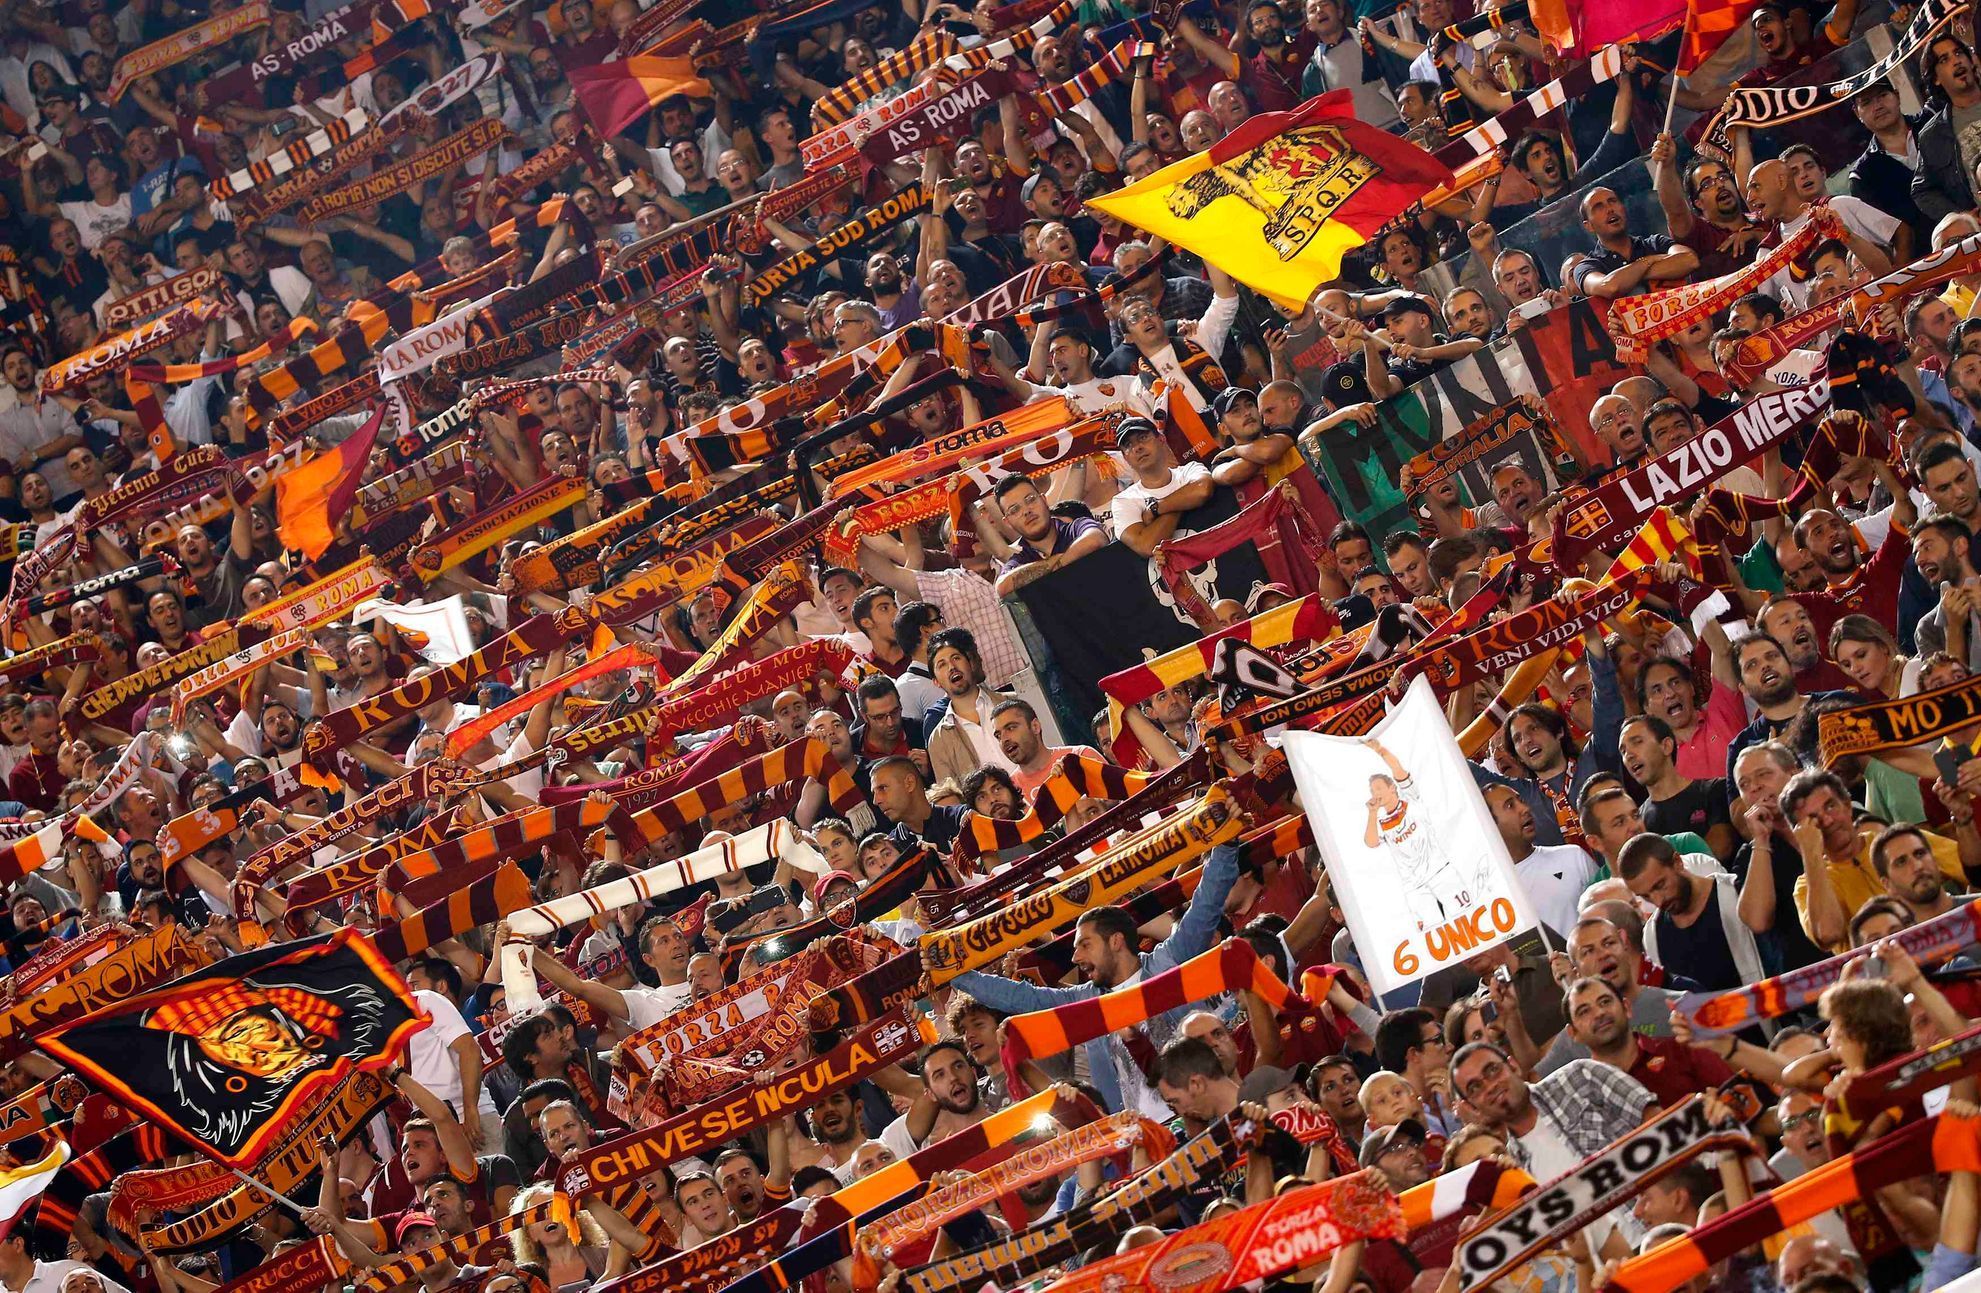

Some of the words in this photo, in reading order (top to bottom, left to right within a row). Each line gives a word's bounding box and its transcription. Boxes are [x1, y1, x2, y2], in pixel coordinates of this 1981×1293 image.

[291, 19, 348, 64] ROMA
[929, 82, 991, 130] ROMA
[336, 128, 386, 165] ROMA
[303, 198, 324, 220] LA
[325, 186, 366, 214] ROMA
[366, 176, 398, 201] NON
[413, 145, 468, 177] DISCUTE
[816, 219, 865, 256] SUD
[868, 187, 935, 229] ROMA
[109, 286, 168, 320] OTTI
[66, 319, 172, 382] ROMA
[412, 321, 465, 360] ROM
[446, 332, 533, 376] FORZA
[419, 398, 471, 438] roma
[933, 418, 1010, 456] roma
[1619, 427, 1735, 514] LAZIO
[1733, 377, 1830, 453] MERD
[146, 492, 226, 544] OMA
[245, 440, 304, 488] 927
[872, 486, 946, 524] FORZ
[456, 488, 562, 546] ASSOCIAZIONE
[781, 539, 815, 567] FORTI
[74, 566, 141, 596] roma
[316, 570, 374, 613] ROMA
[1475, 643, 1533, 675] VENI
[1535, 617, 1584, 649] VIDI
[1586, 589, 1633, 622] VICI
[179, 660, 231, 694] ORZA
[351, 630, 536, 732] ROMA
[705, 664, 762, 696] CLUB
[668, 693, 743, 731] VECCHIE
[1260, 706, 1291, 725] NOI
[1294, 688, 1343, 713] SEMO
[624, 758, 690, 790] ROMA
[626, 788, 660, 811] 1927
[246, 774, 414, 877] PANUCCI
[328, 818, 367, 845] GRINTA
[1394, 819, 1418, 846] WIND
[323, 826, 441, 893] ROM
[1453, 889, 1472, 908] 10
[1392, 938, 1421, 972] 6
[1425, 896, 1516, 960] UNICO
[70, 936, 194, 1010] ROMA
[680, 1008, 708, 1024] ROMA
[710, 994, 732, 1012] NON
[746, 967, 786, 995] DISCUTE
[761, 979, 826, 1052] ROMA
[647, 1002, 746, 1064] FORZA
[1003, 1123, 1112, 1185] ROMA
[1579, 1098, 1713, 1200] ROM
[165, 1196, 239, 1246] ODIO
[279, 1097, 354, 1179] TUTTI
[1262, 1205, 1329, 1238] FORZA
[1251, 1221, 1342, 1275] ROMA
